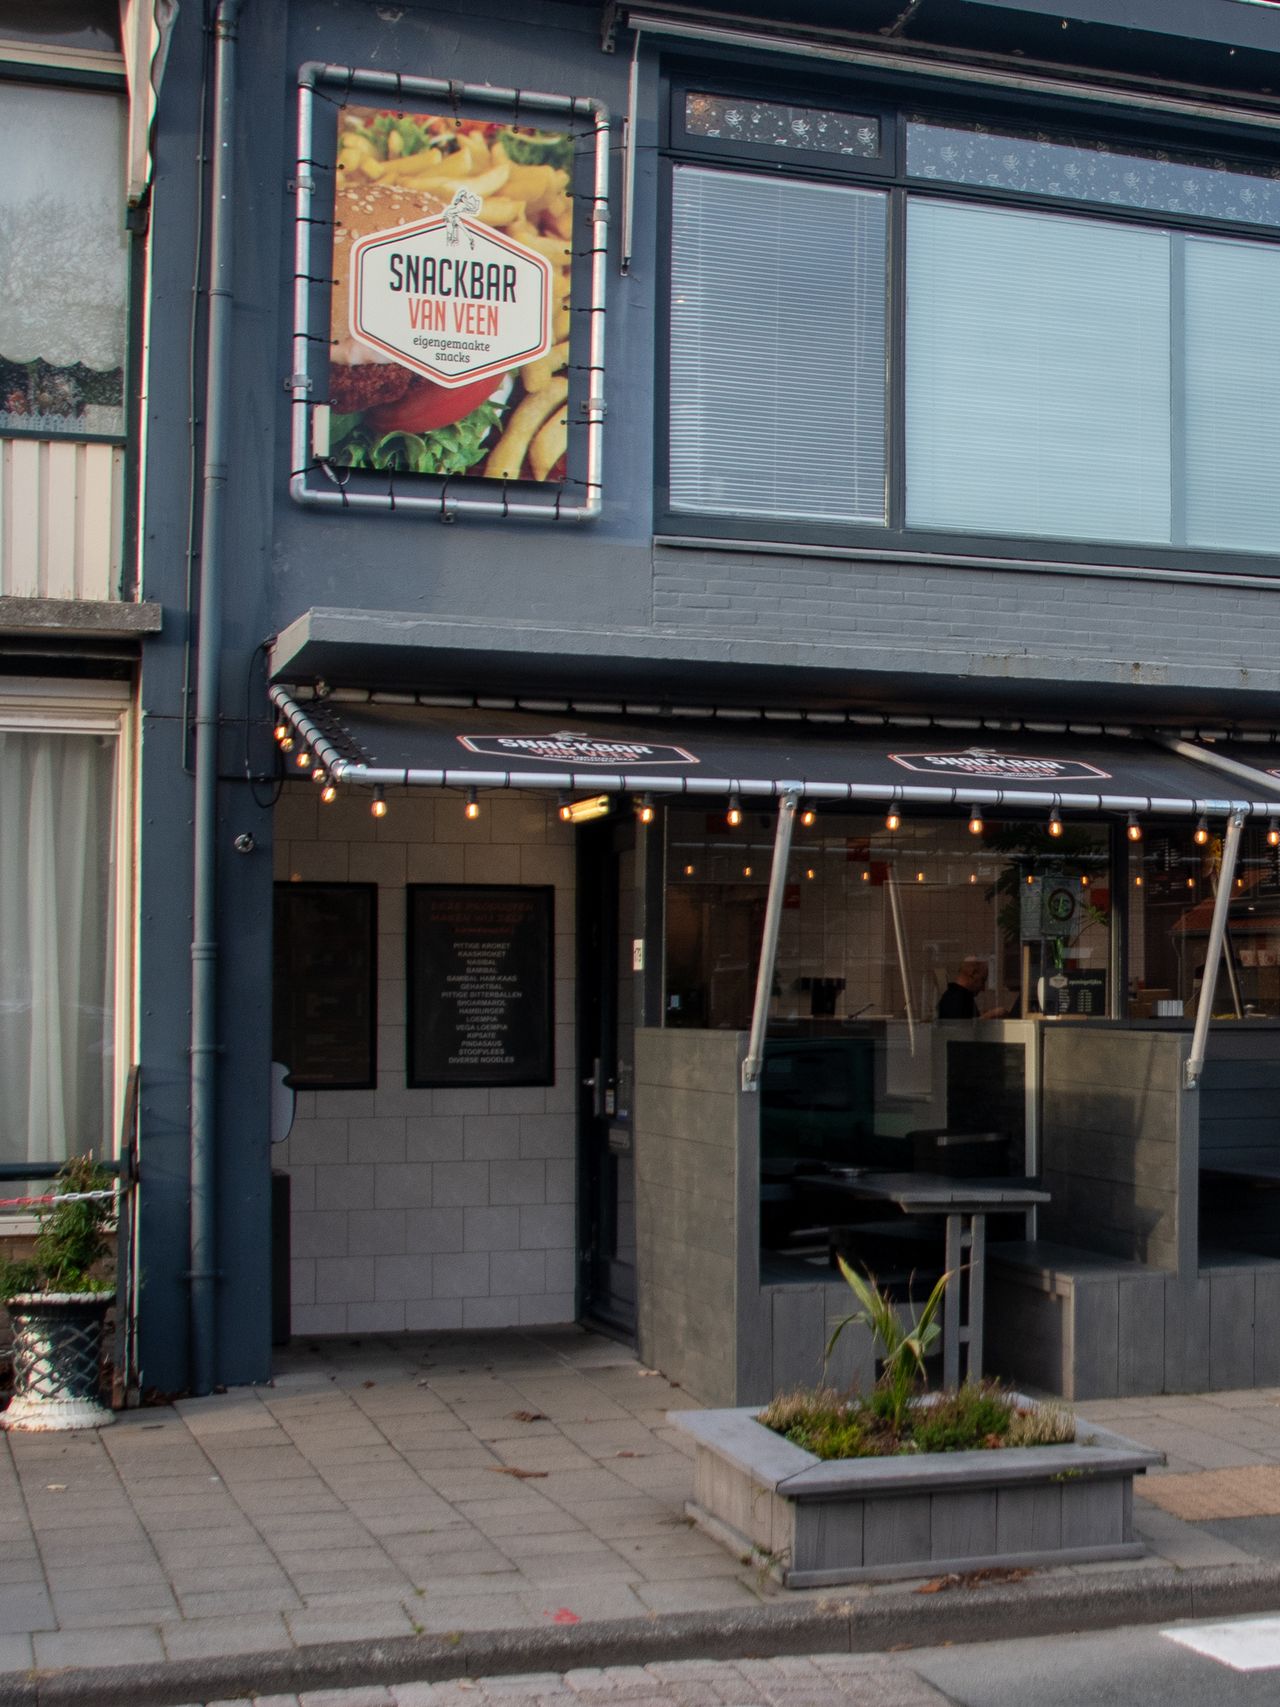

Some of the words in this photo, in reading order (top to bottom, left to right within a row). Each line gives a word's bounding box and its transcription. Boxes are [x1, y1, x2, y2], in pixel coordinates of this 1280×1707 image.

[389, 253, 516, 303] SNACKBAR
[408, 298, 446, 332] VAN
[453, 302, 499, 336] VEEN
[413, 336, 490, 352] eigengemaakte
[435, 351, 470, 363] snacks
[497, 739, 654, 754] SNACKBAR
[528, 748, 578, 756] VAN
[581, 749, 640, 759] VEEN
[924, 756, 1066, 769] SNACKBAR
[448, 1056, 479, 1064] DIVERSE
